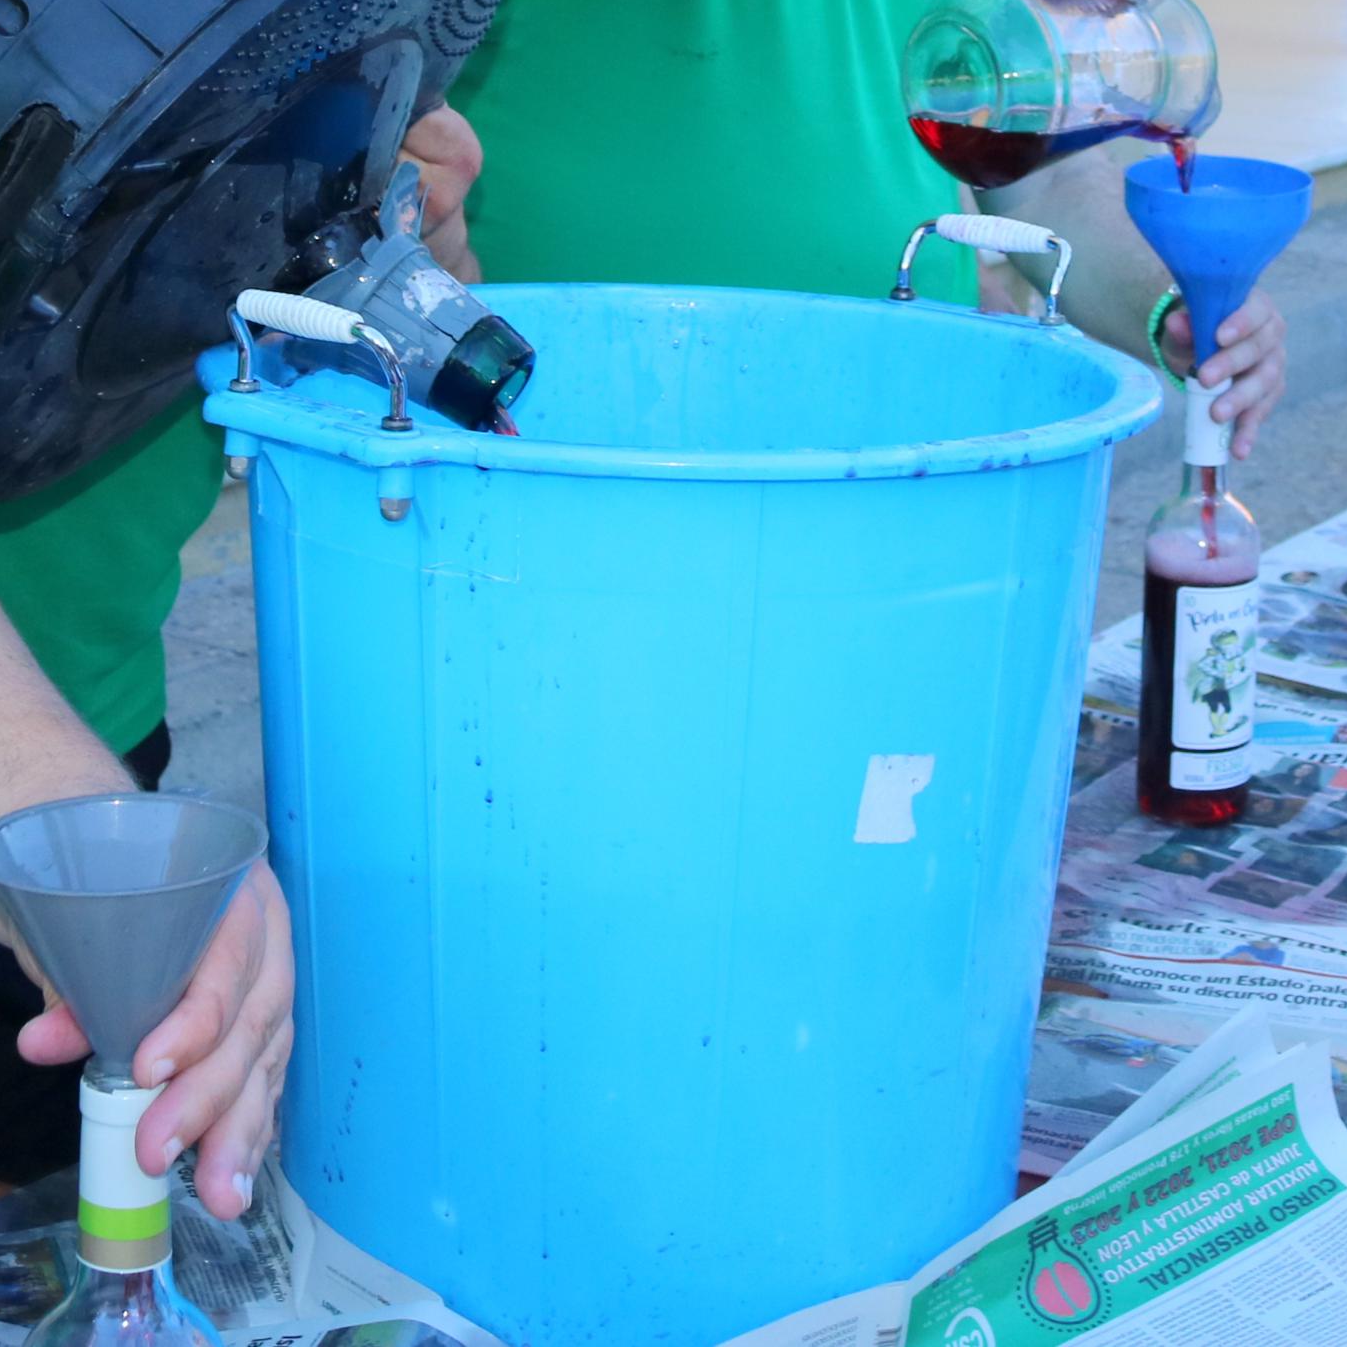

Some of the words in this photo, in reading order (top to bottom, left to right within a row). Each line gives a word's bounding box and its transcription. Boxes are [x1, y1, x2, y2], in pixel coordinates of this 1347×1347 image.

[1087, 972, 1163, 991] inflama
[1166, 984, 1191, 994] su
[1111, 963, 1203, 983] reconoce
[1206, 974, 1232, 984] un
[1235, 974, 1305, 990] Estado
[1256, 1112, 1297, 1148] OPE
[1198, 1133, 1255, 1175] 2021,
[1250, 1141, 1303, 1178] JUNTA
[1142, 1165, 1195, 1207] 2022
[1229, 1169, 1252, 1187] de
[1244, 1158, 1320, 1207] AUXILIAR
[1127, 1190, 1142, 1215] y
[1153, 1182, 1232, 1230] CASTILLA
[1268, 1177, 1338, 1223] CURSO
[1070, 1203, 1123, 1246] 2023
[1102, 1198, 1246, 1284] ADMINISTRATIVO
[1141, 1218, 1155, 1237] y
[1097, 1229, 1142, 1264] LEÓN
[1137, 1214, 1270, 1292] PRESENCIAL
